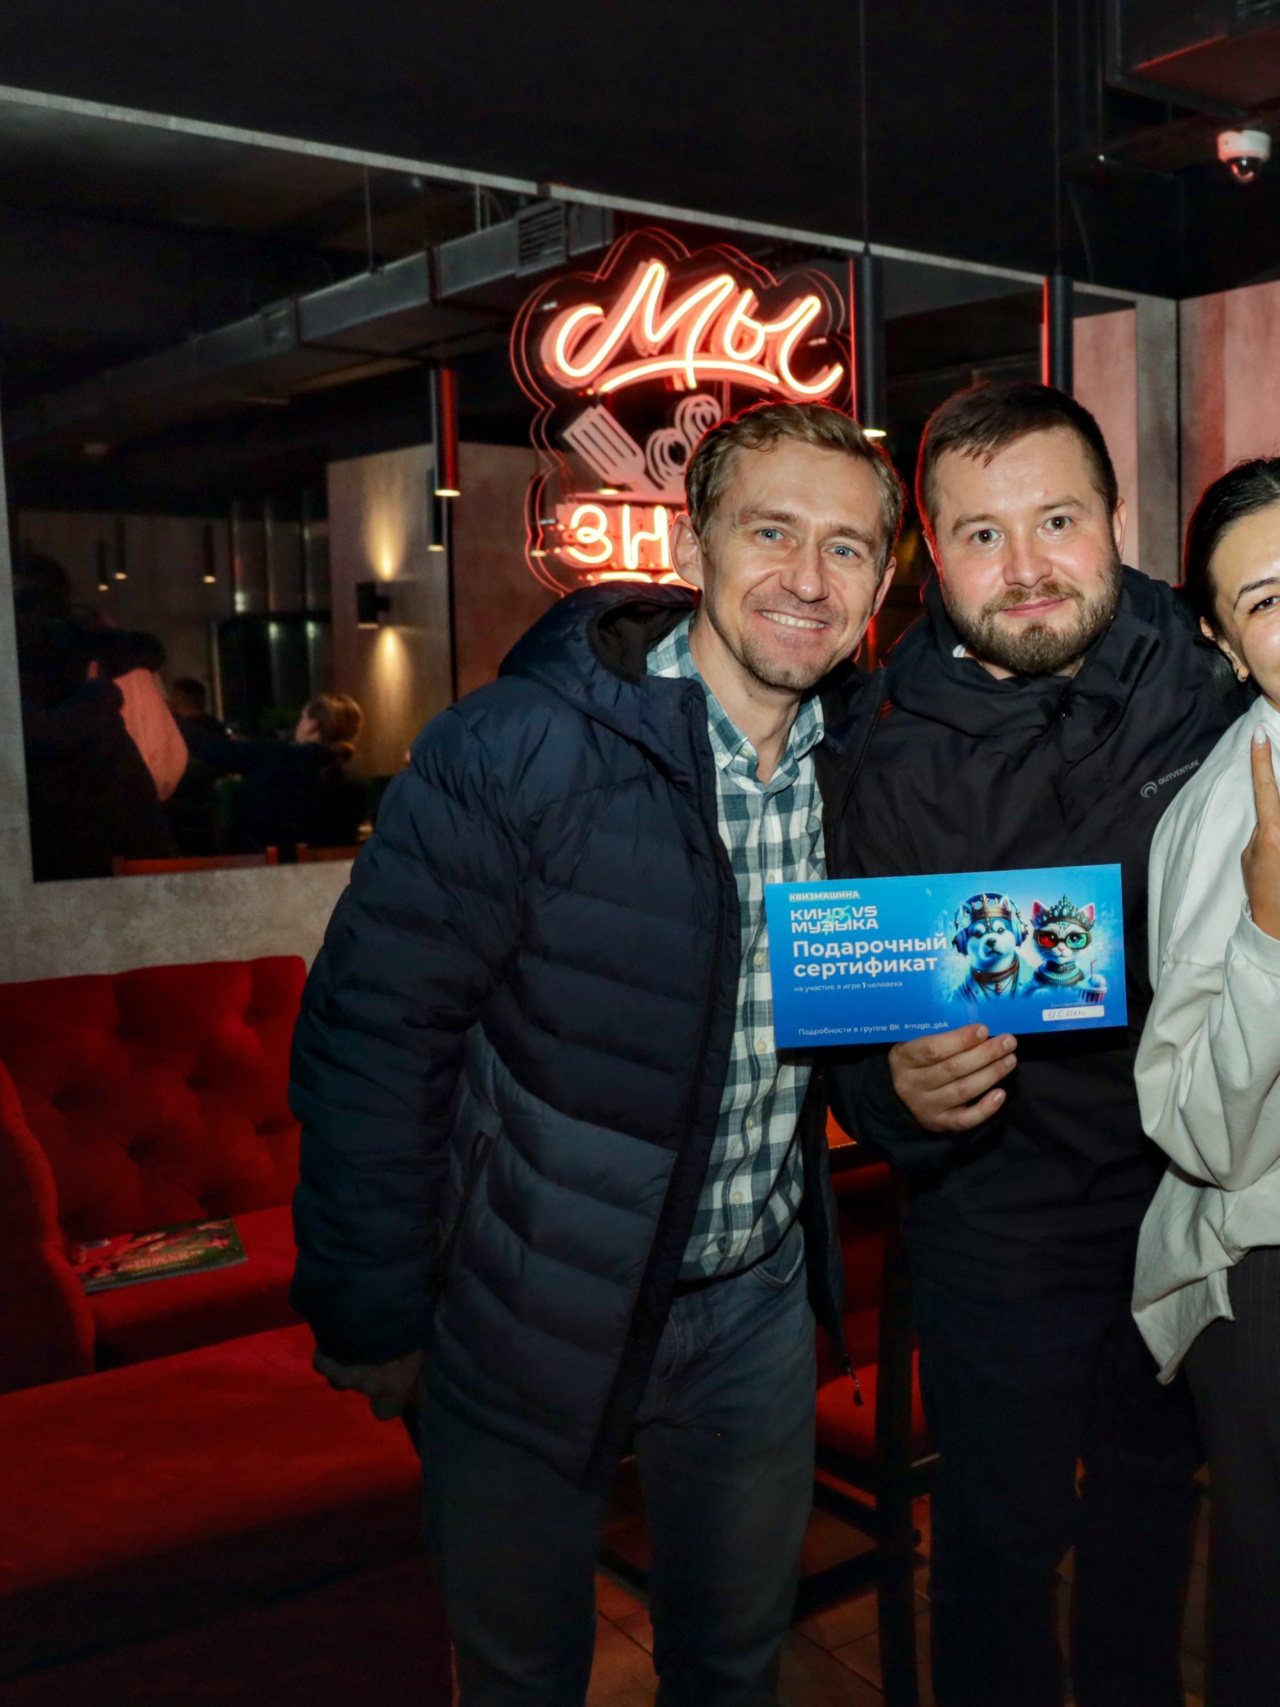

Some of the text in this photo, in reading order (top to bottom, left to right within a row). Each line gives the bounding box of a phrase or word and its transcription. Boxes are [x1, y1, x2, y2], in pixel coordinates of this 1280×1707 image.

[566, 503, 671, 570] ЗН
[789, 890, 861, 902] КВИЗМАШИНА
[790, 905, 878, 921] КИНО VS
[791, 918, 879, 934] МУЗЫКА
[793, 932, 948, 959] Подарочный
[793, 956, 938, 980] сертификат
[804, 984, 835, 993] участие
[843, 982, 861, 991] игре
[798, 1027, 852, 1036] Подробности
[860, 1025, 888, 1034] группе
[889, 1023, 900, 1031] ВК
